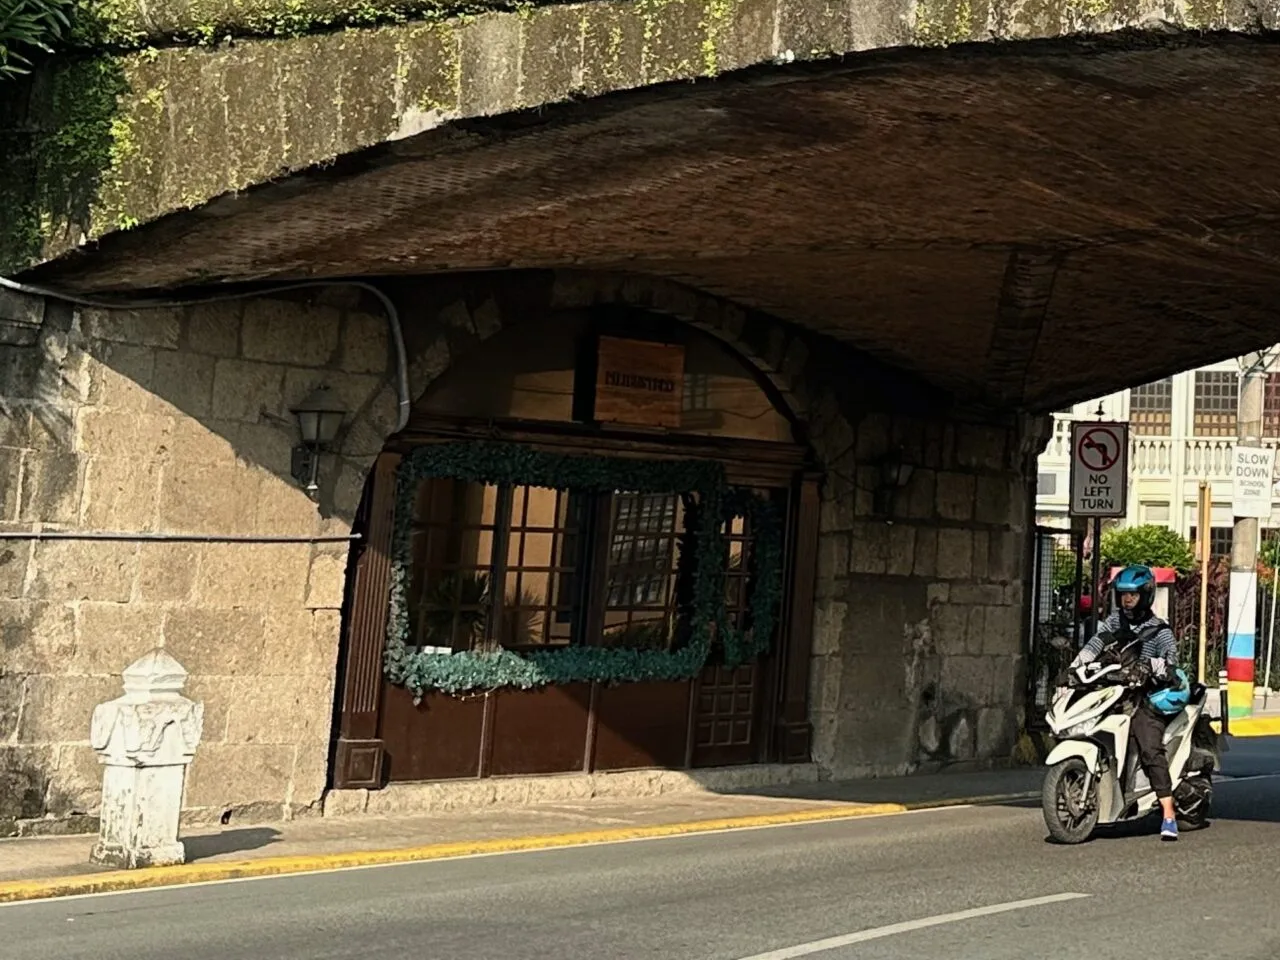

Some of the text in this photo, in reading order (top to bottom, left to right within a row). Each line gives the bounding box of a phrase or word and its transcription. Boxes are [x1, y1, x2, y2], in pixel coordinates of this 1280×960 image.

[1238, 453, 1269, 465] SLOW
[1236, 466, 1269, 478] DOWN
[1089, 474, 1108, 485] NO
[1084, 486, 1111, 497] LEFT
[1080, 499, 1114, 509] TURN
